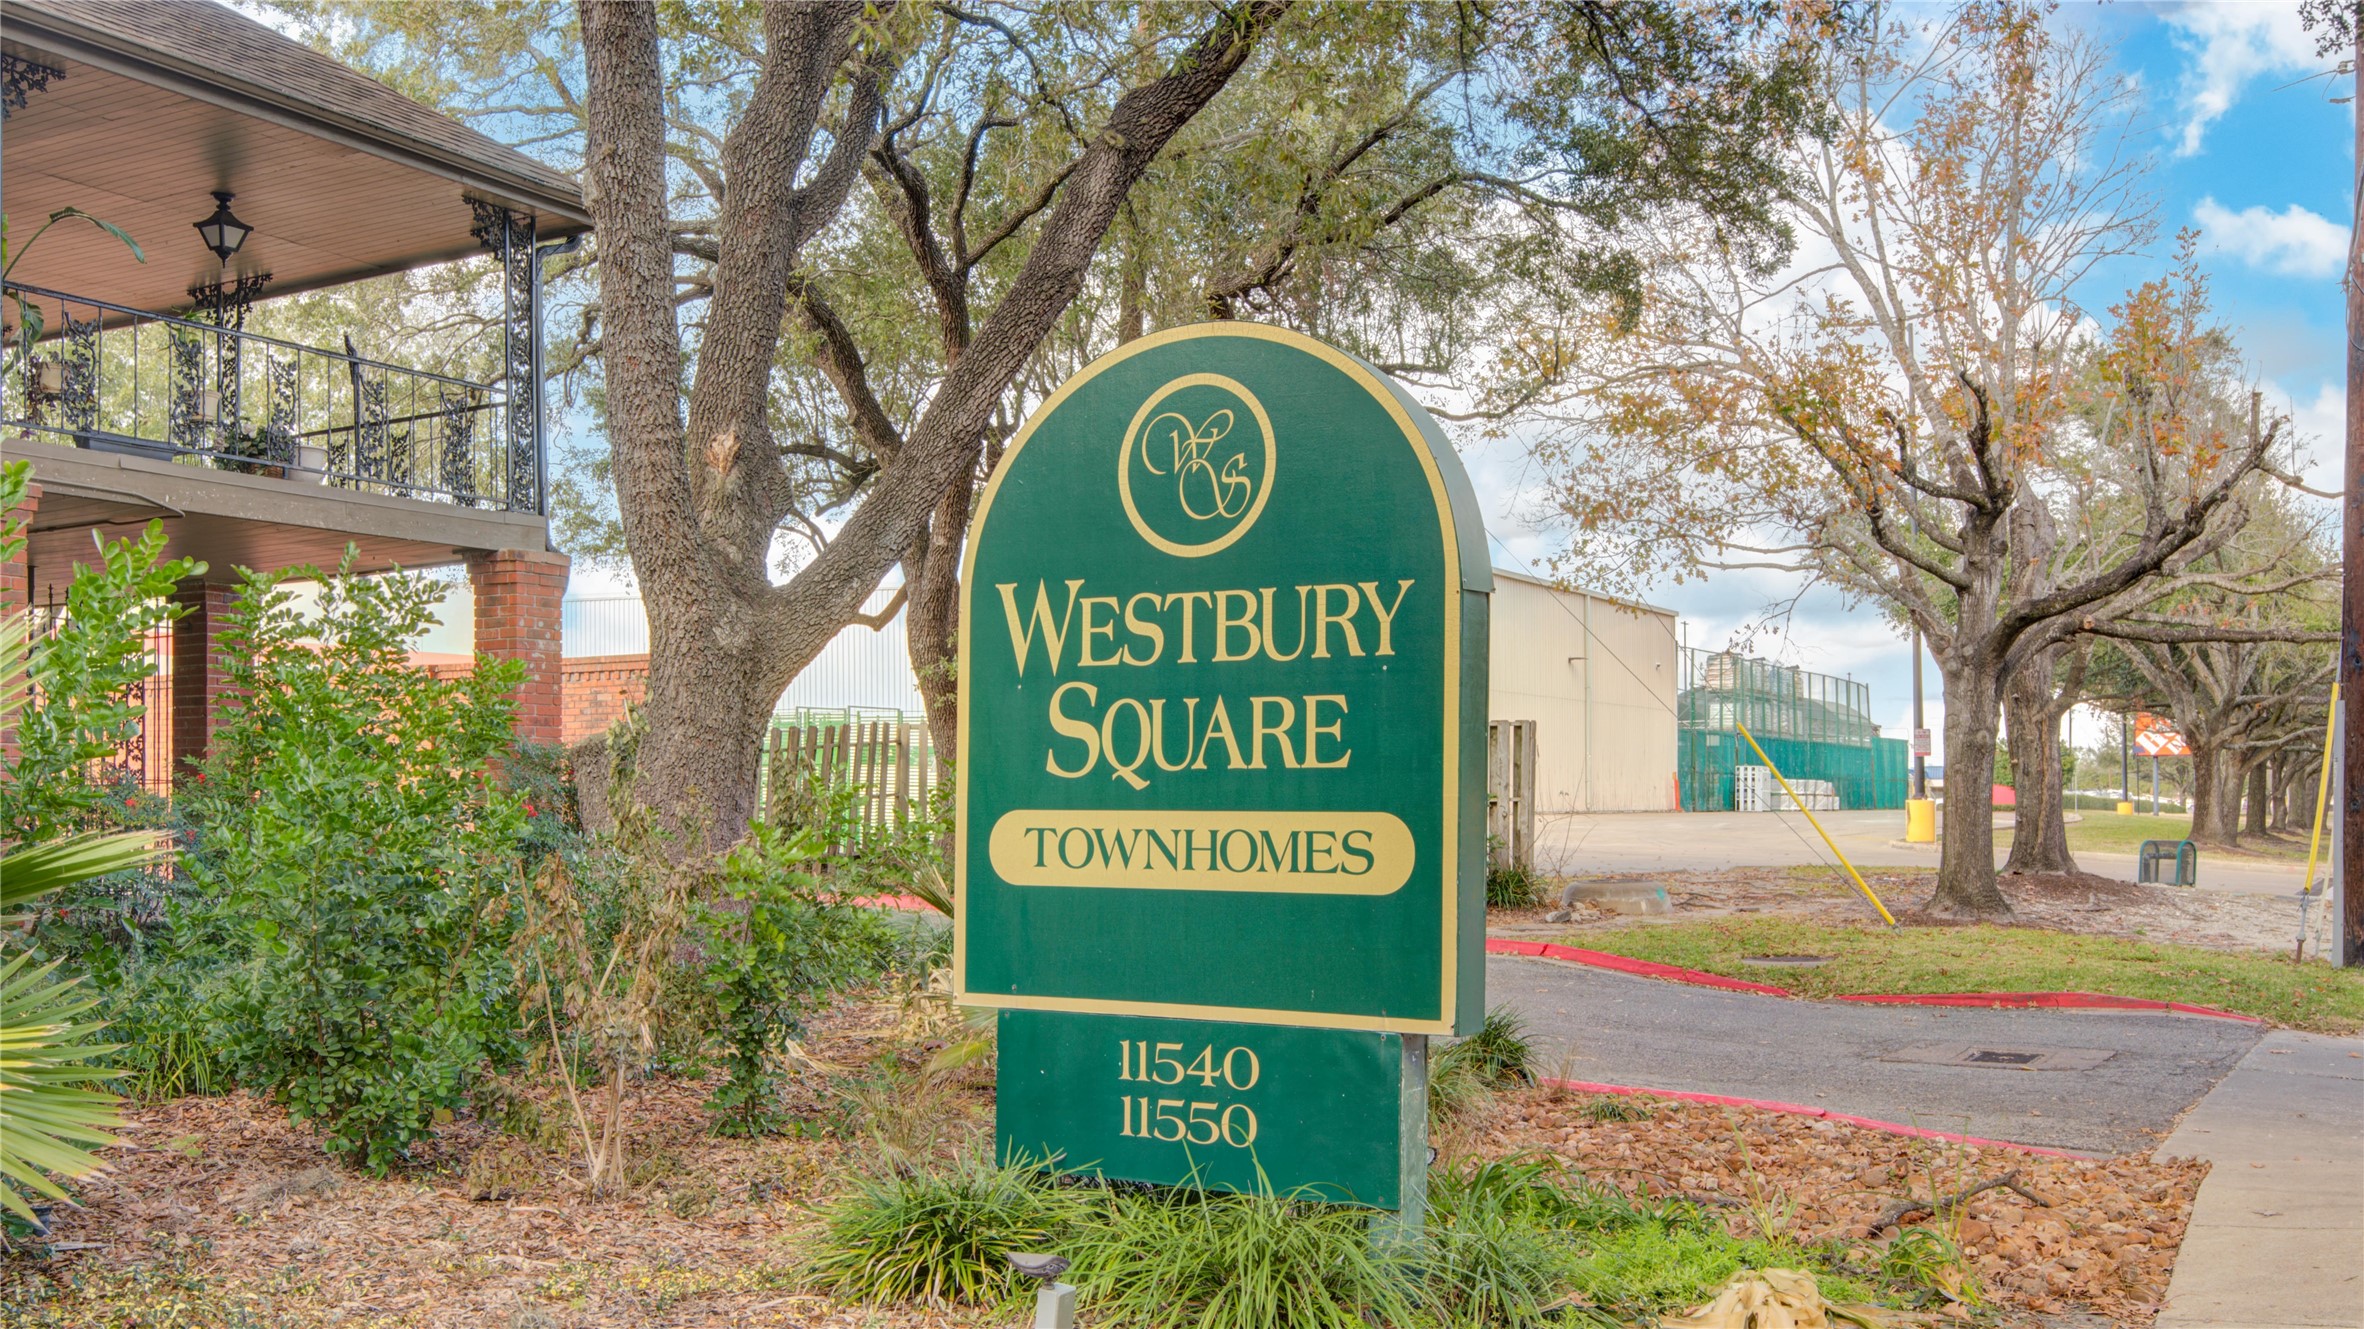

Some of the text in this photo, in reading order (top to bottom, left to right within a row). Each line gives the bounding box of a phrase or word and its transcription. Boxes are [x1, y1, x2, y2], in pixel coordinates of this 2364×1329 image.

[995, 578, 1415, 677] WESTBURY
[1045, 681, 1352, 791] SQUARE
[1024, 827, 1375, 876] TOWNHOMES
[1119, 1039, 1260, 1091] 11540
[1120, 1095, 1258, 1148] 11550
